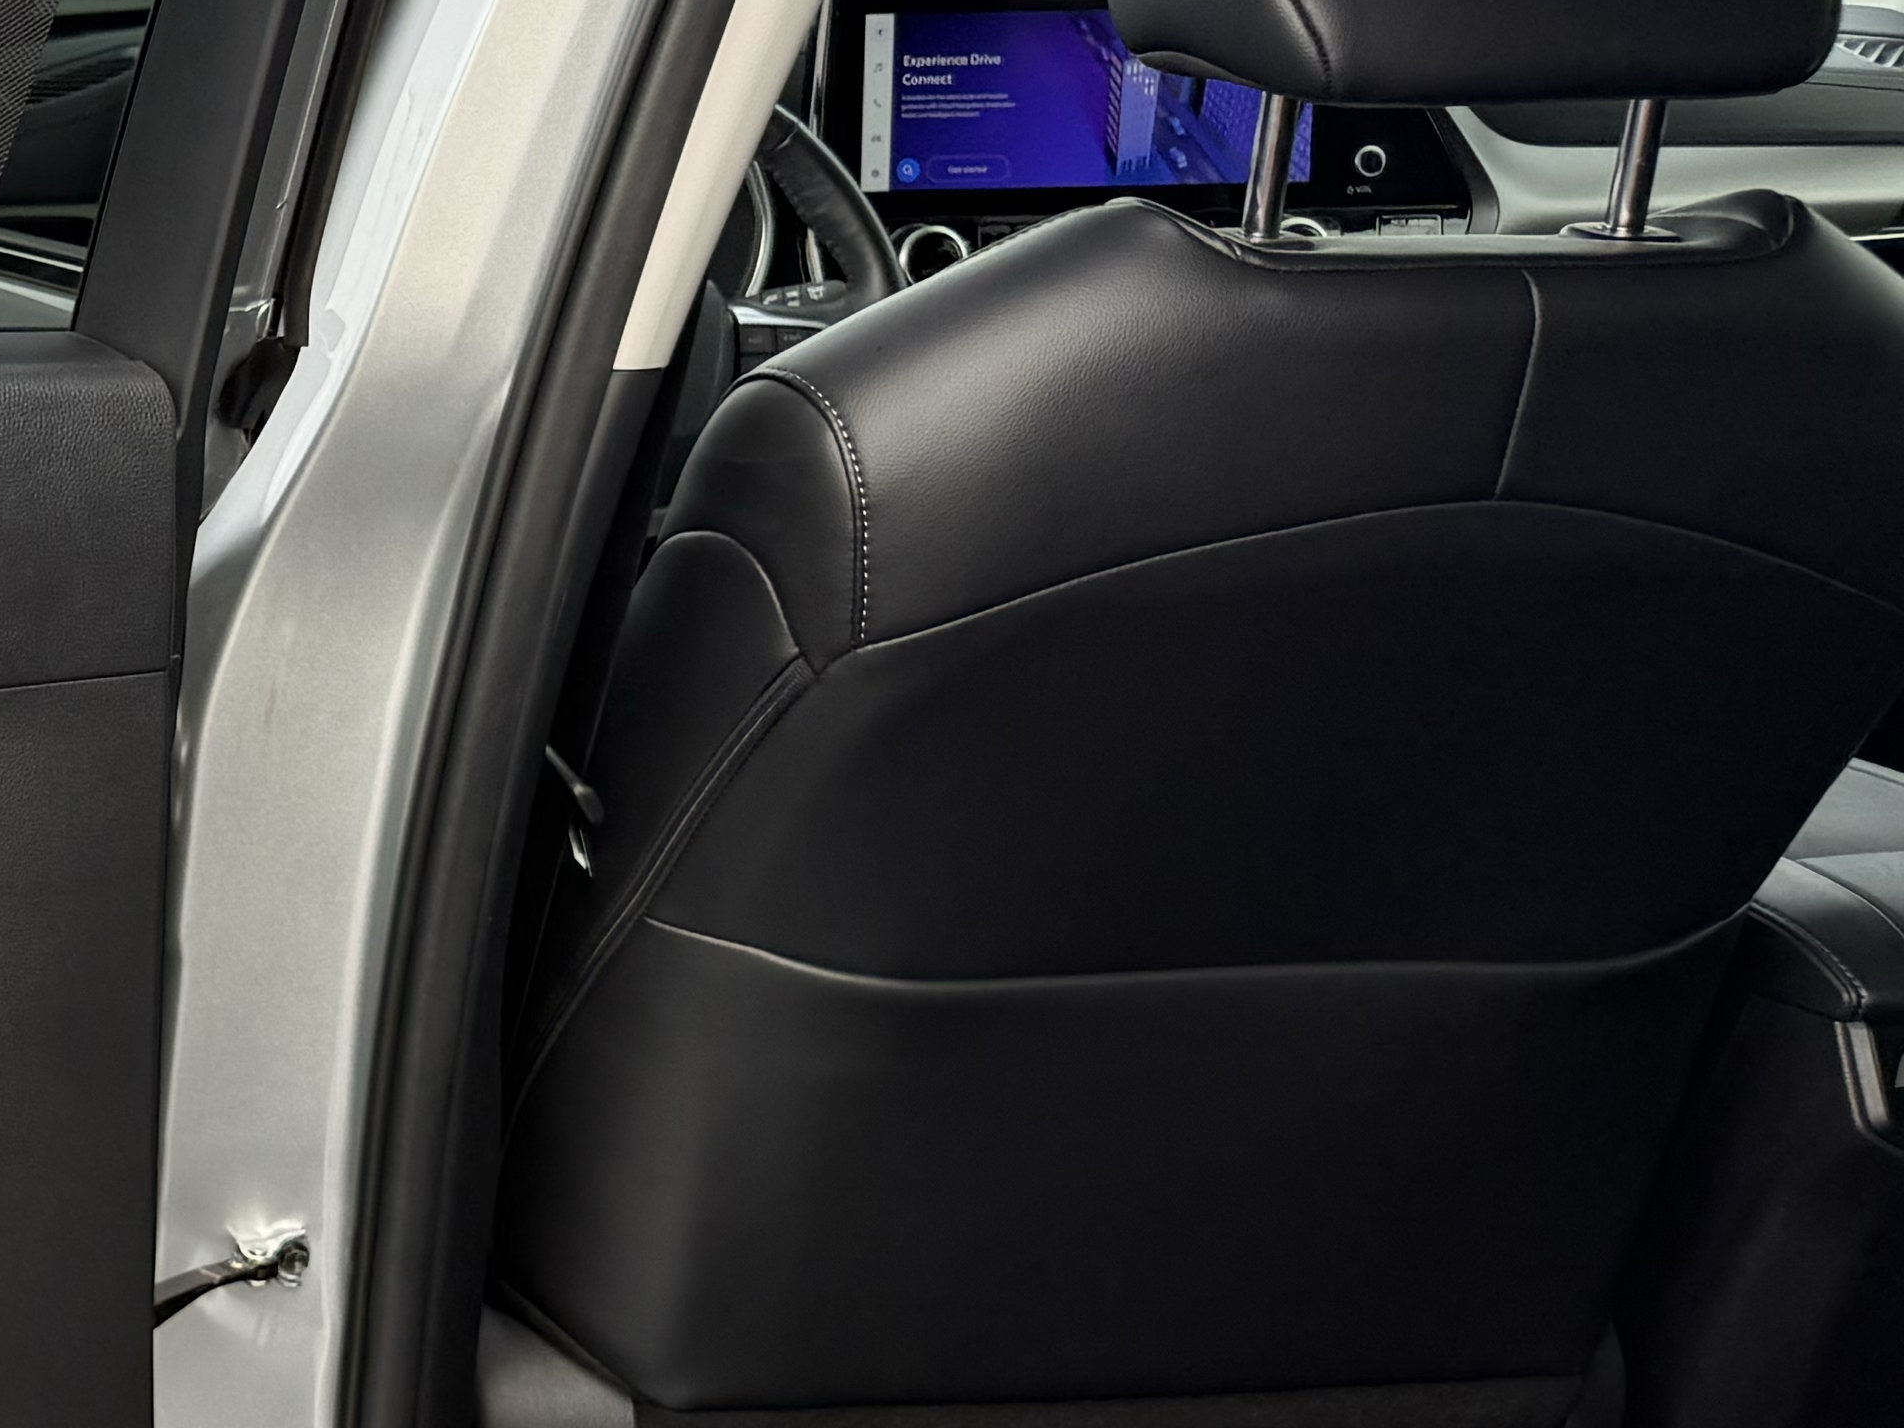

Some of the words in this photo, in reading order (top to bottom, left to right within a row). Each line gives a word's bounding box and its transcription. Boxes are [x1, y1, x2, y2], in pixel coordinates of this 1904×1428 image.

[903, 54, 968, 68] Experience
[970, 53, 1002, 66] Drive
[902, 73, 953, 86] Connect
